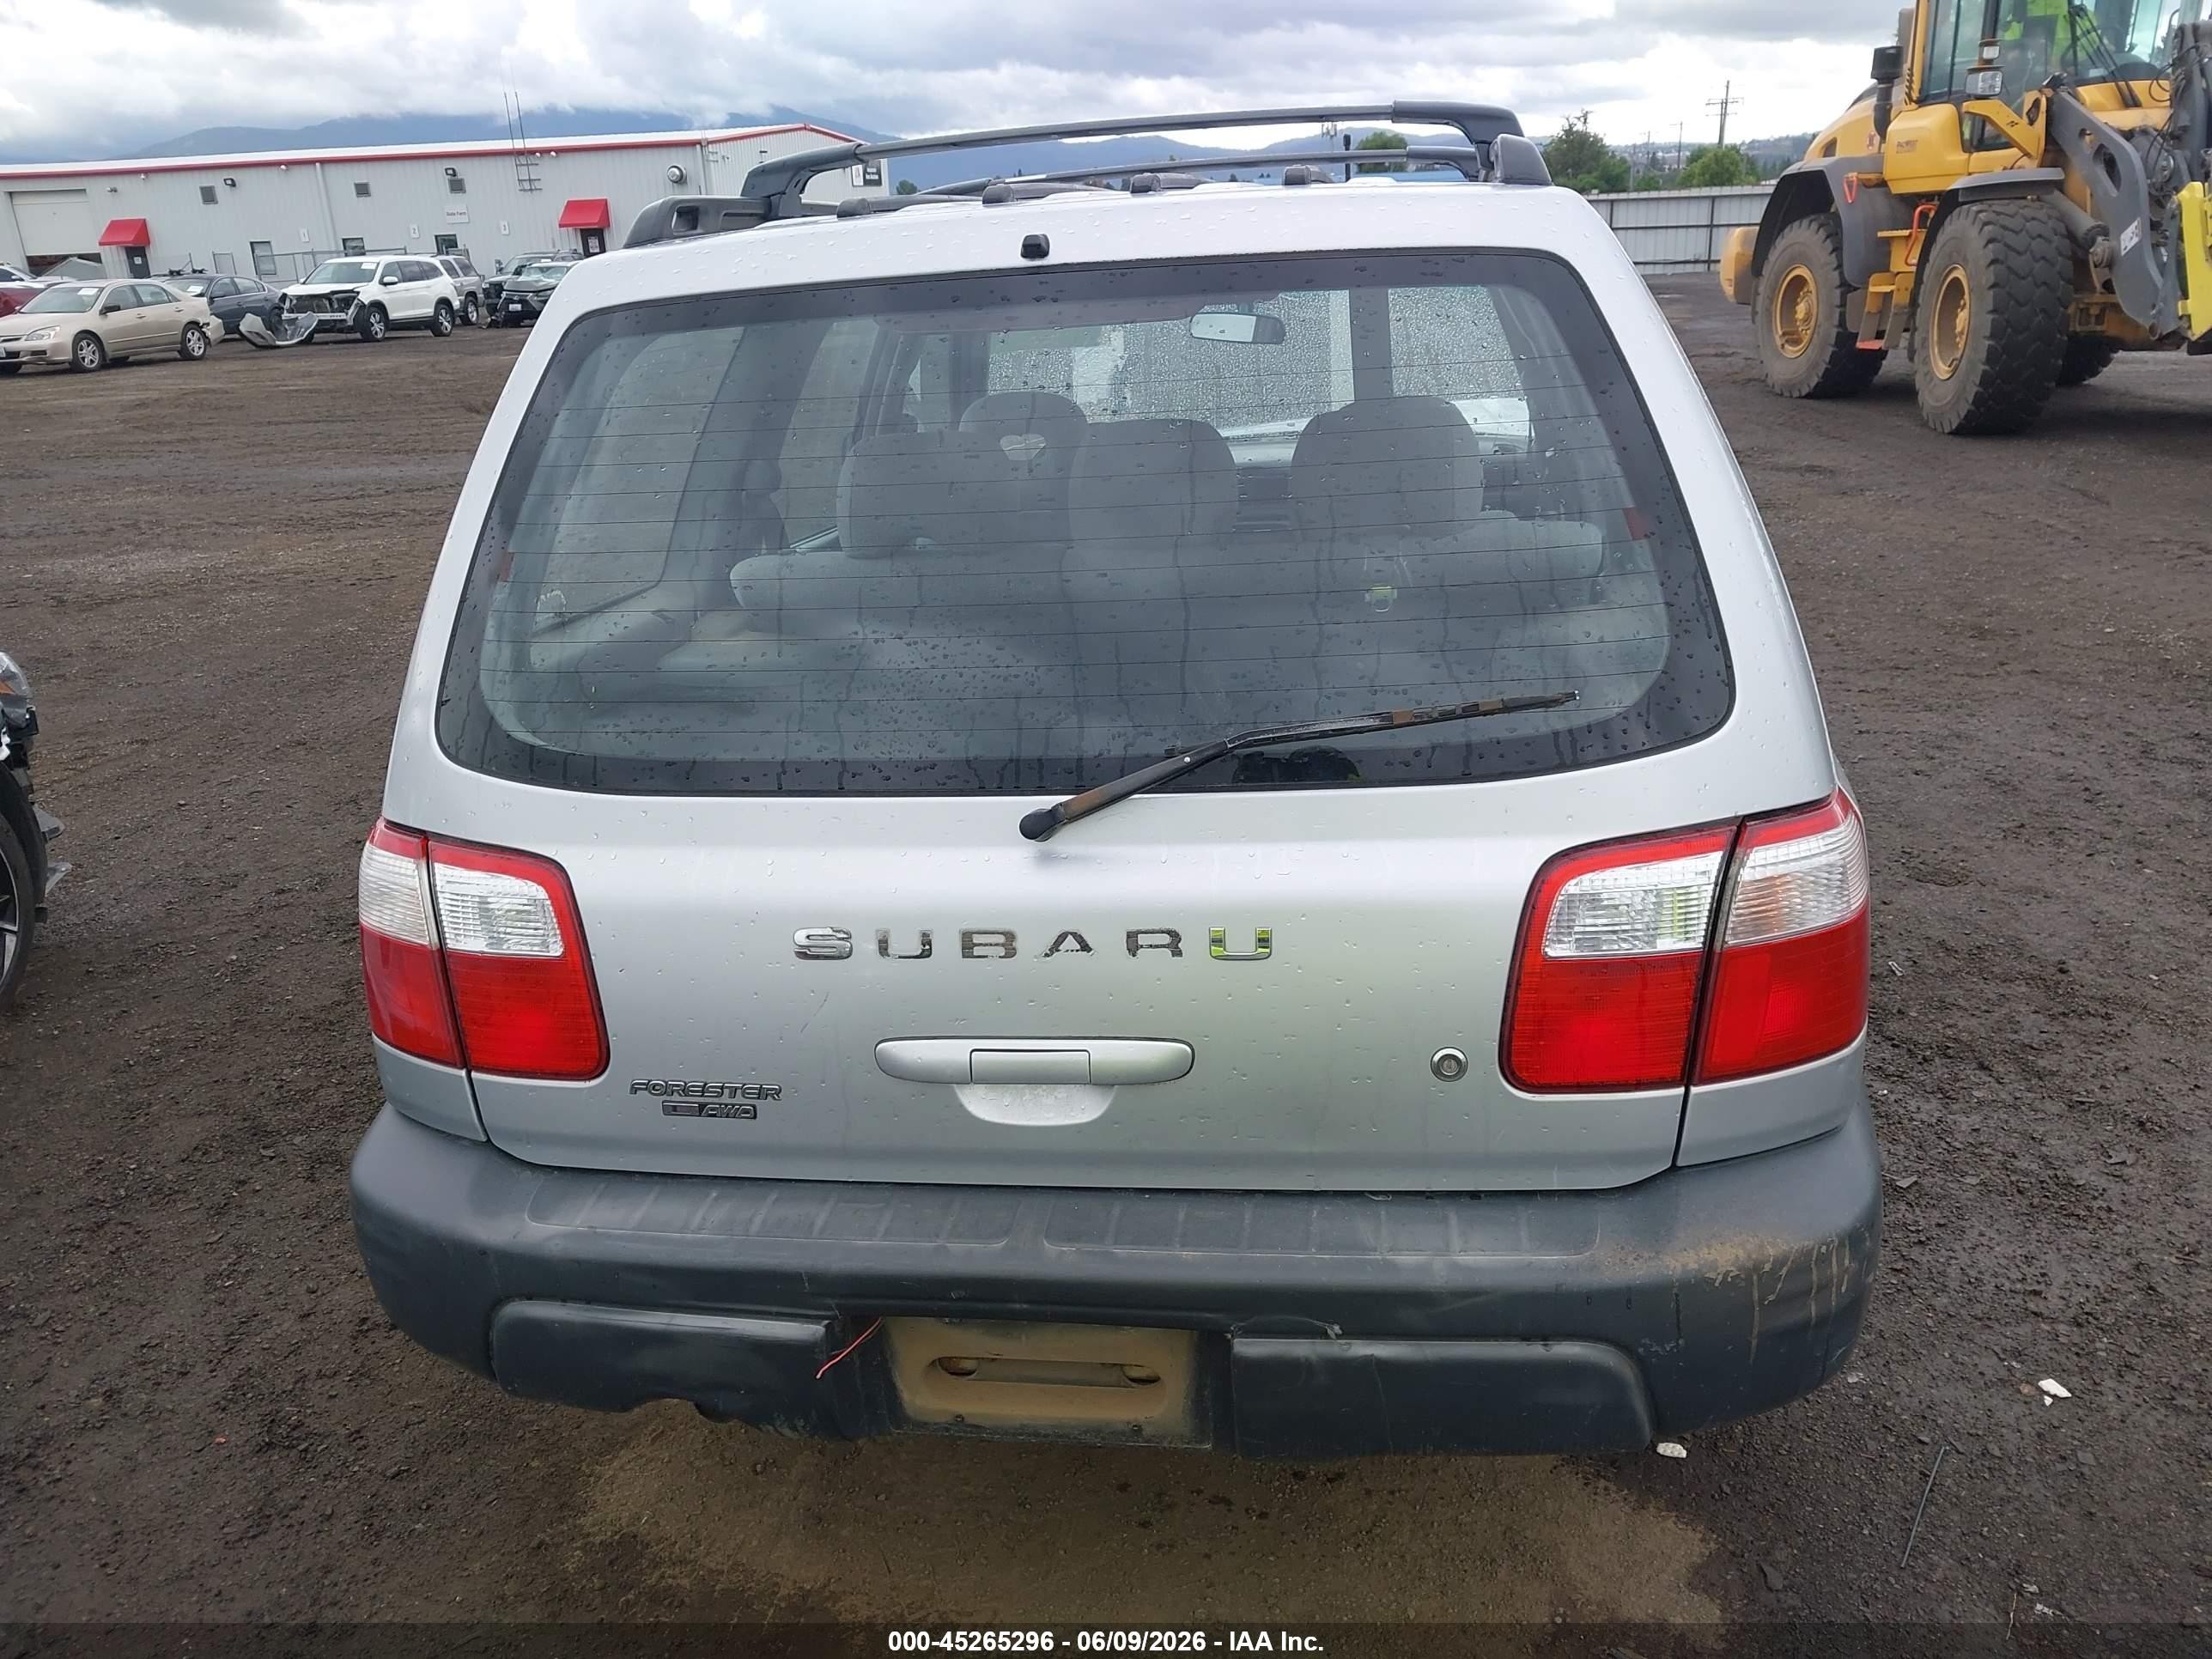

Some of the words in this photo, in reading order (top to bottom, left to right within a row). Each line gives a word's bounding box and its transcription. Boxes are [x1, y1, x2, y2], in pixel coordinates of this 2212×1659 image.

[792, 927, 1273, 961] SUBARU
[629, 1079, 782, 1100] FORESTER
[700, 1104, 756, 1119] AWD
